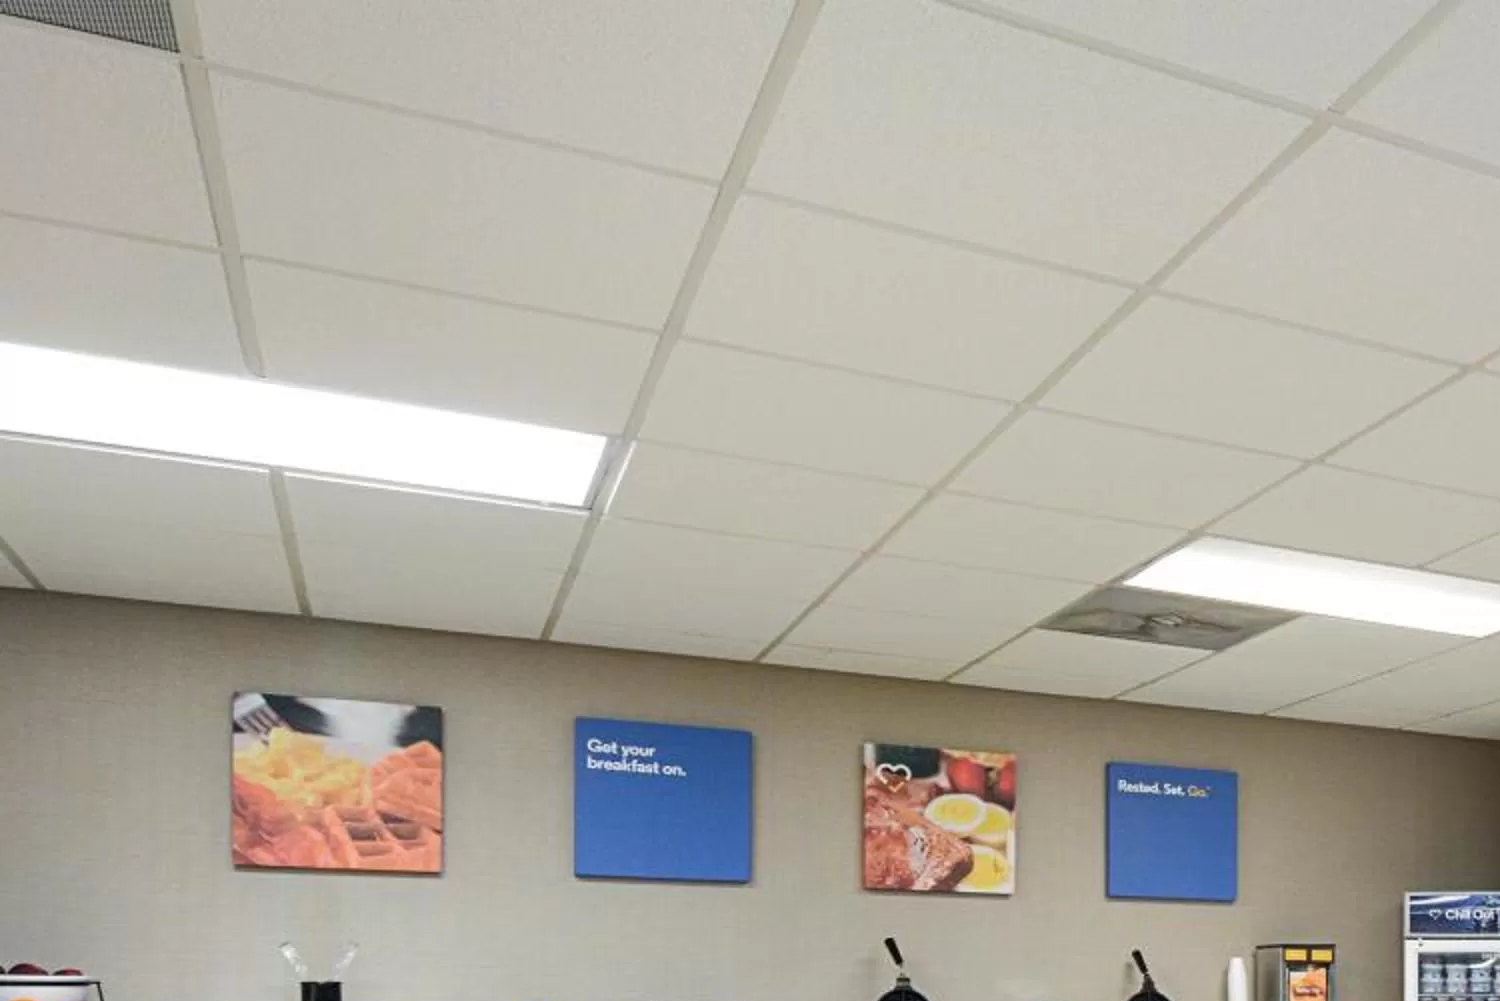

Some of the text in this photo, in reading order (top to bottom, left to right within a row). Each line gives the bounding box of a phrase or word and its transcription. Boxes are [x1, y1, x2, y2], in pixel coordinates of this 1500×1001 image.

[587, 738, 656, 757] Get your
[587, 757, 687, 777] breakfast on.
